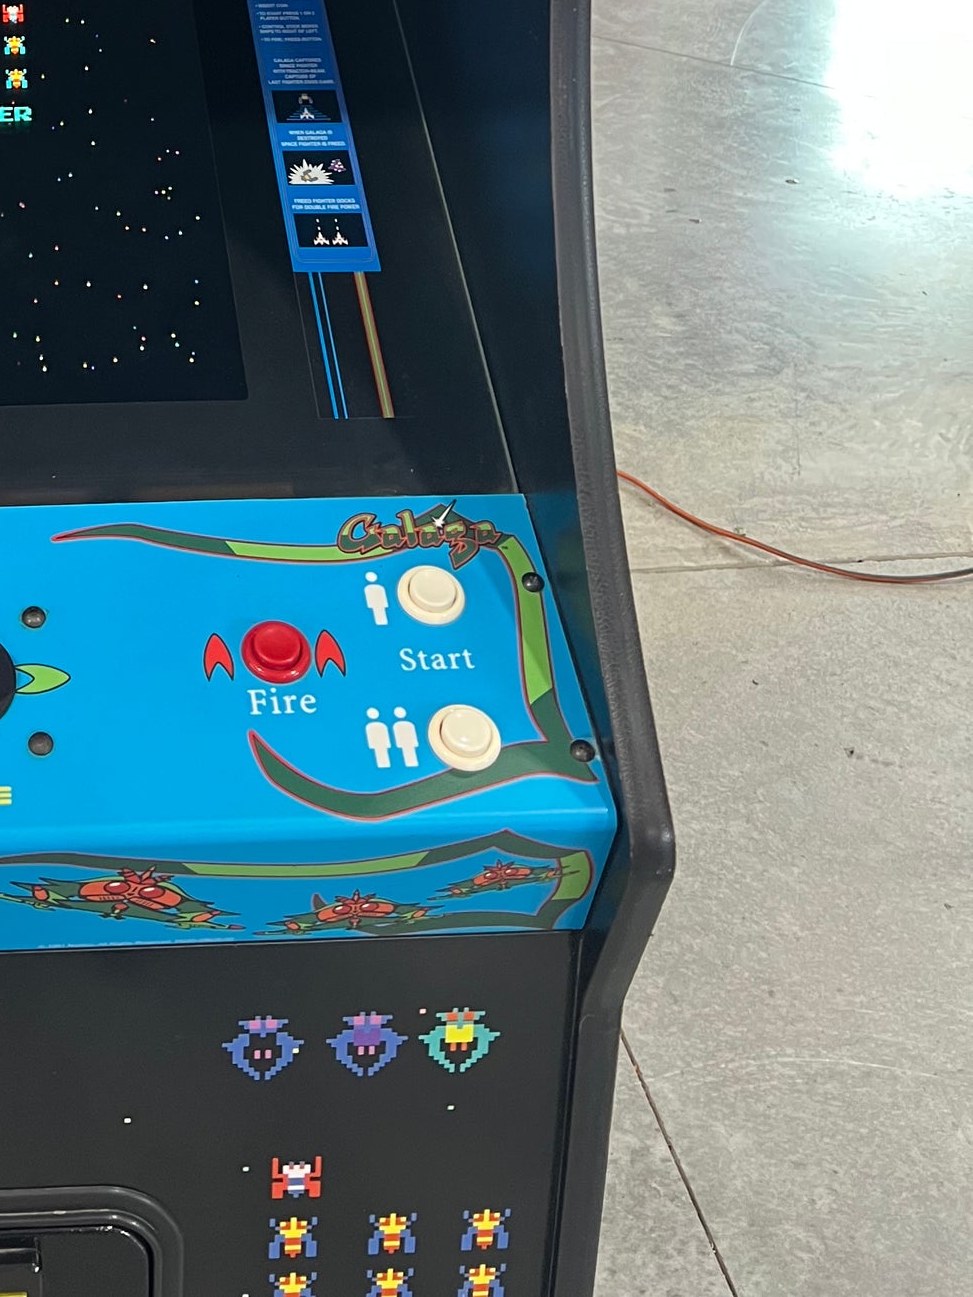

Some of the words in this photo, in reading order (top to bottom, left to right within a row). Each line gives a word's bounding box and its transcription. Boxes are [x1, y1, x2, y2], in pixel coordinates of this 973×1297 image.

[337, 508, 504, 570] Galaga
[399, 646, 475, 673] Start
[249, 687, 318, 716] Fire
